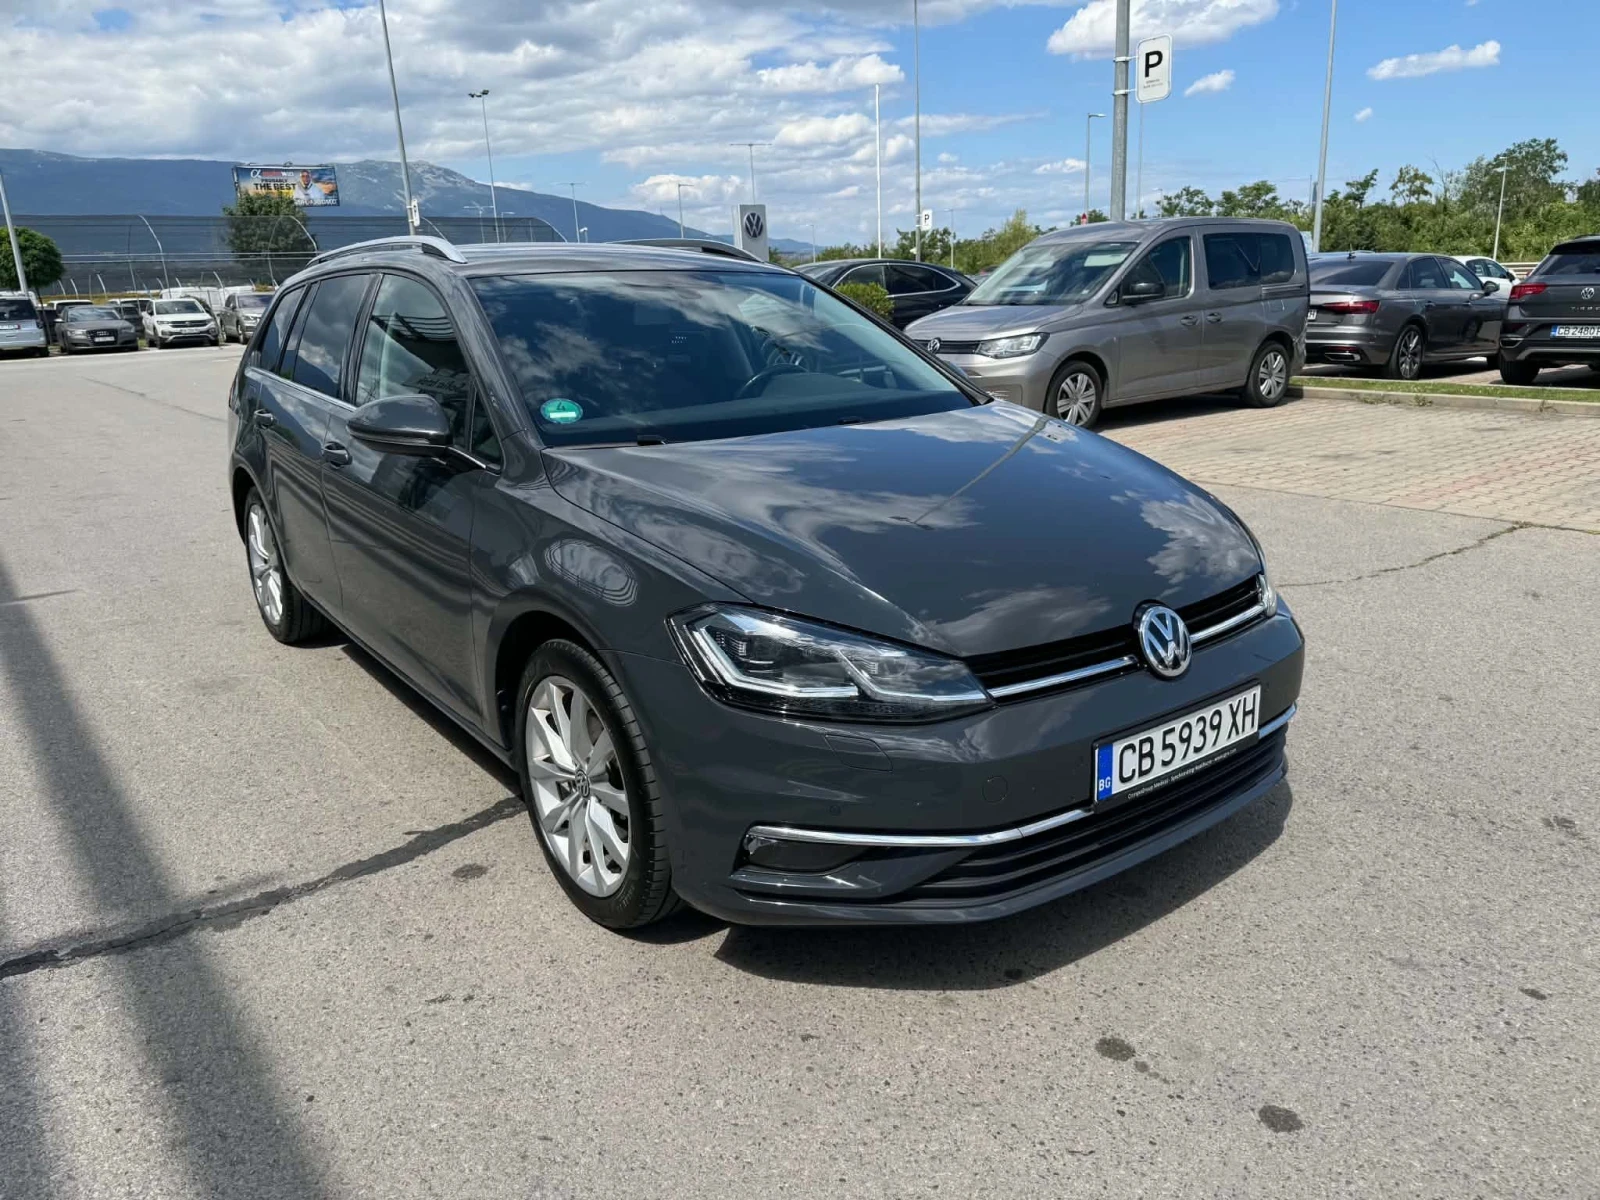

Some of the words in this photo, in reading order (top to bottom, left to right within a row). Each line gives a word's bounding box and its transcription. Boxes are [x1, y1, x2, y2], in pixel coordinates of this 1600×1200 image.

[1144, 50, 1164, 78] P
[253, 183, 272, 191] THE
[273, 183, 296, 191] BEST
[924, 214, 930, 224] P
[1098, 777, 1111, 791] BG
[1118, 736, 1155, 784] CB
[1161, 708, 1222, 766] 5939
[1227, 692, 1257, 740] XH
